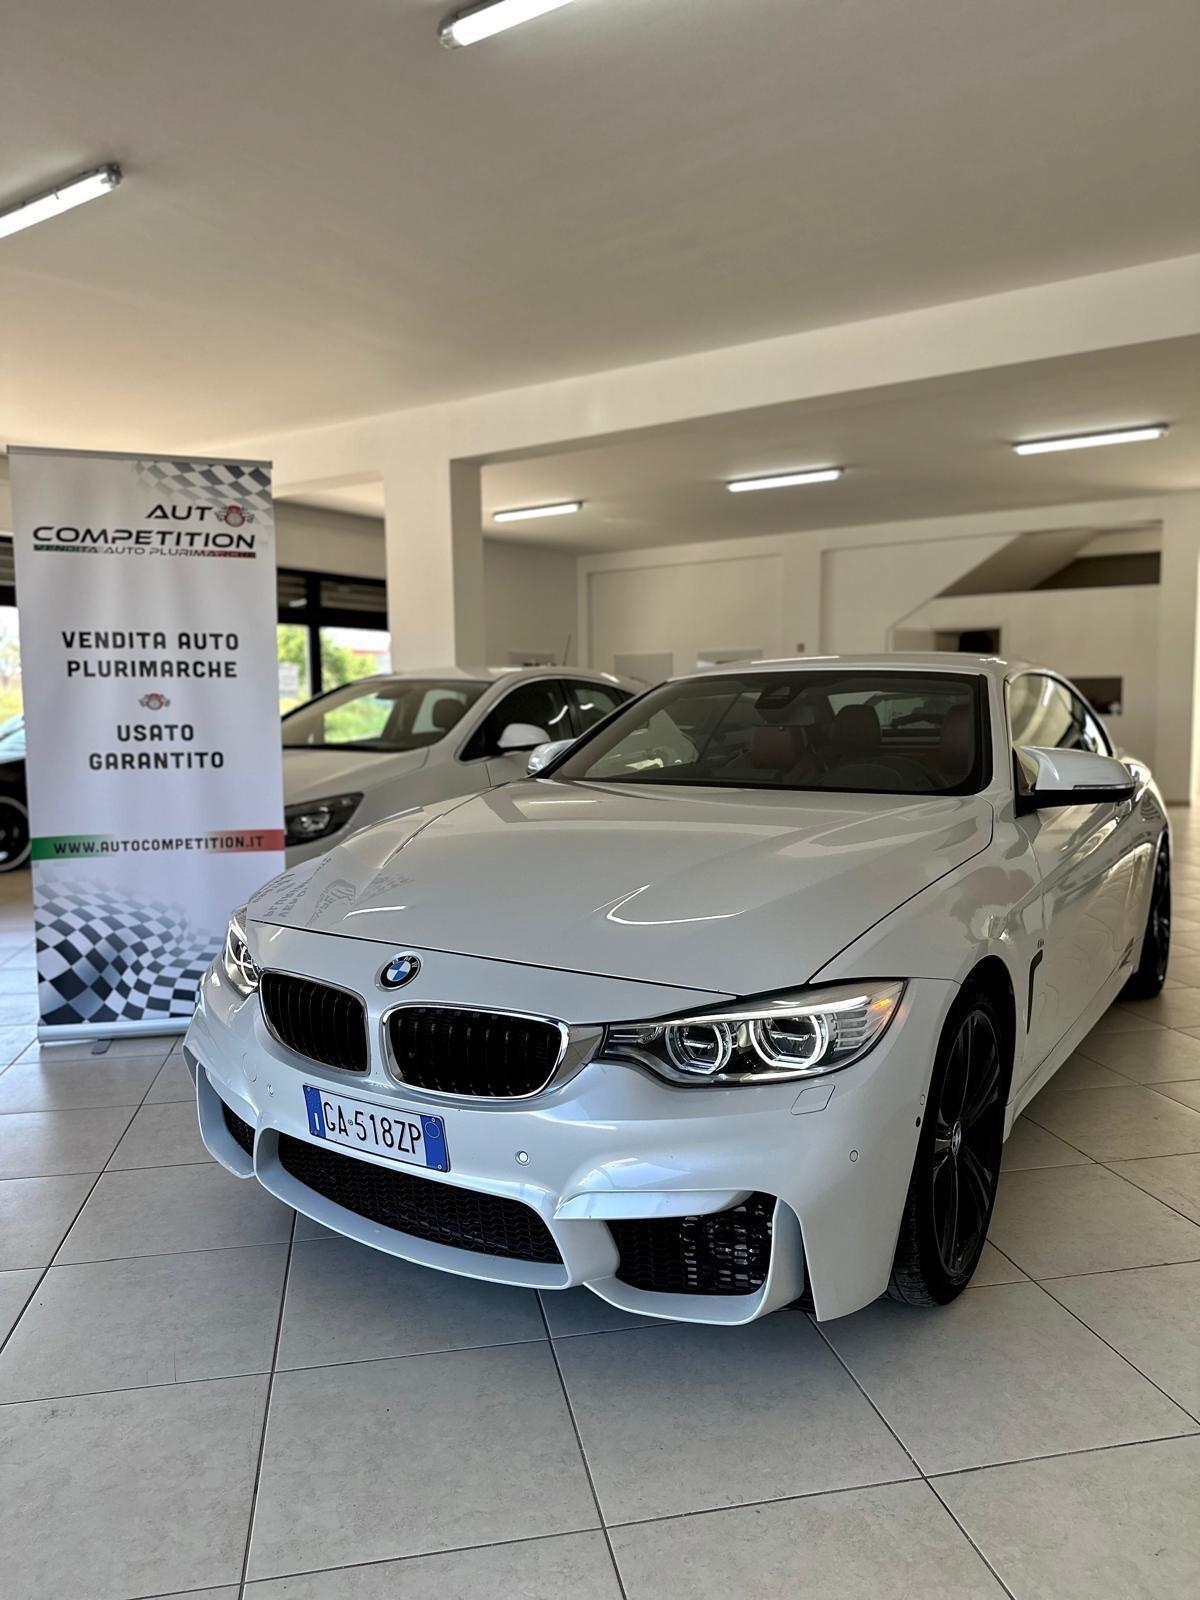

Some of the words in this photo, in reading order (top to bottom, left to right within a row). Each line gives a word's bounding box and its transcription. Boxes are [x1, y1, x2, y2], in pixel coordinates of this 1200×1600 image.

[33, 526, 255, 549] COMPETITION
[104, 546, 145, 556] AUTO
[62, 631, 167, 650] VENDITA
[178, 632, 239, 651] AUTO
[67, 660, 238, 678] PLURIMARCHE
[117, 724, 194, 742] USATO
[89, 752, 224, 770] GARANTITO
[54, 836, 264, 854] WWW.AUTOCOMPETITION.IT
